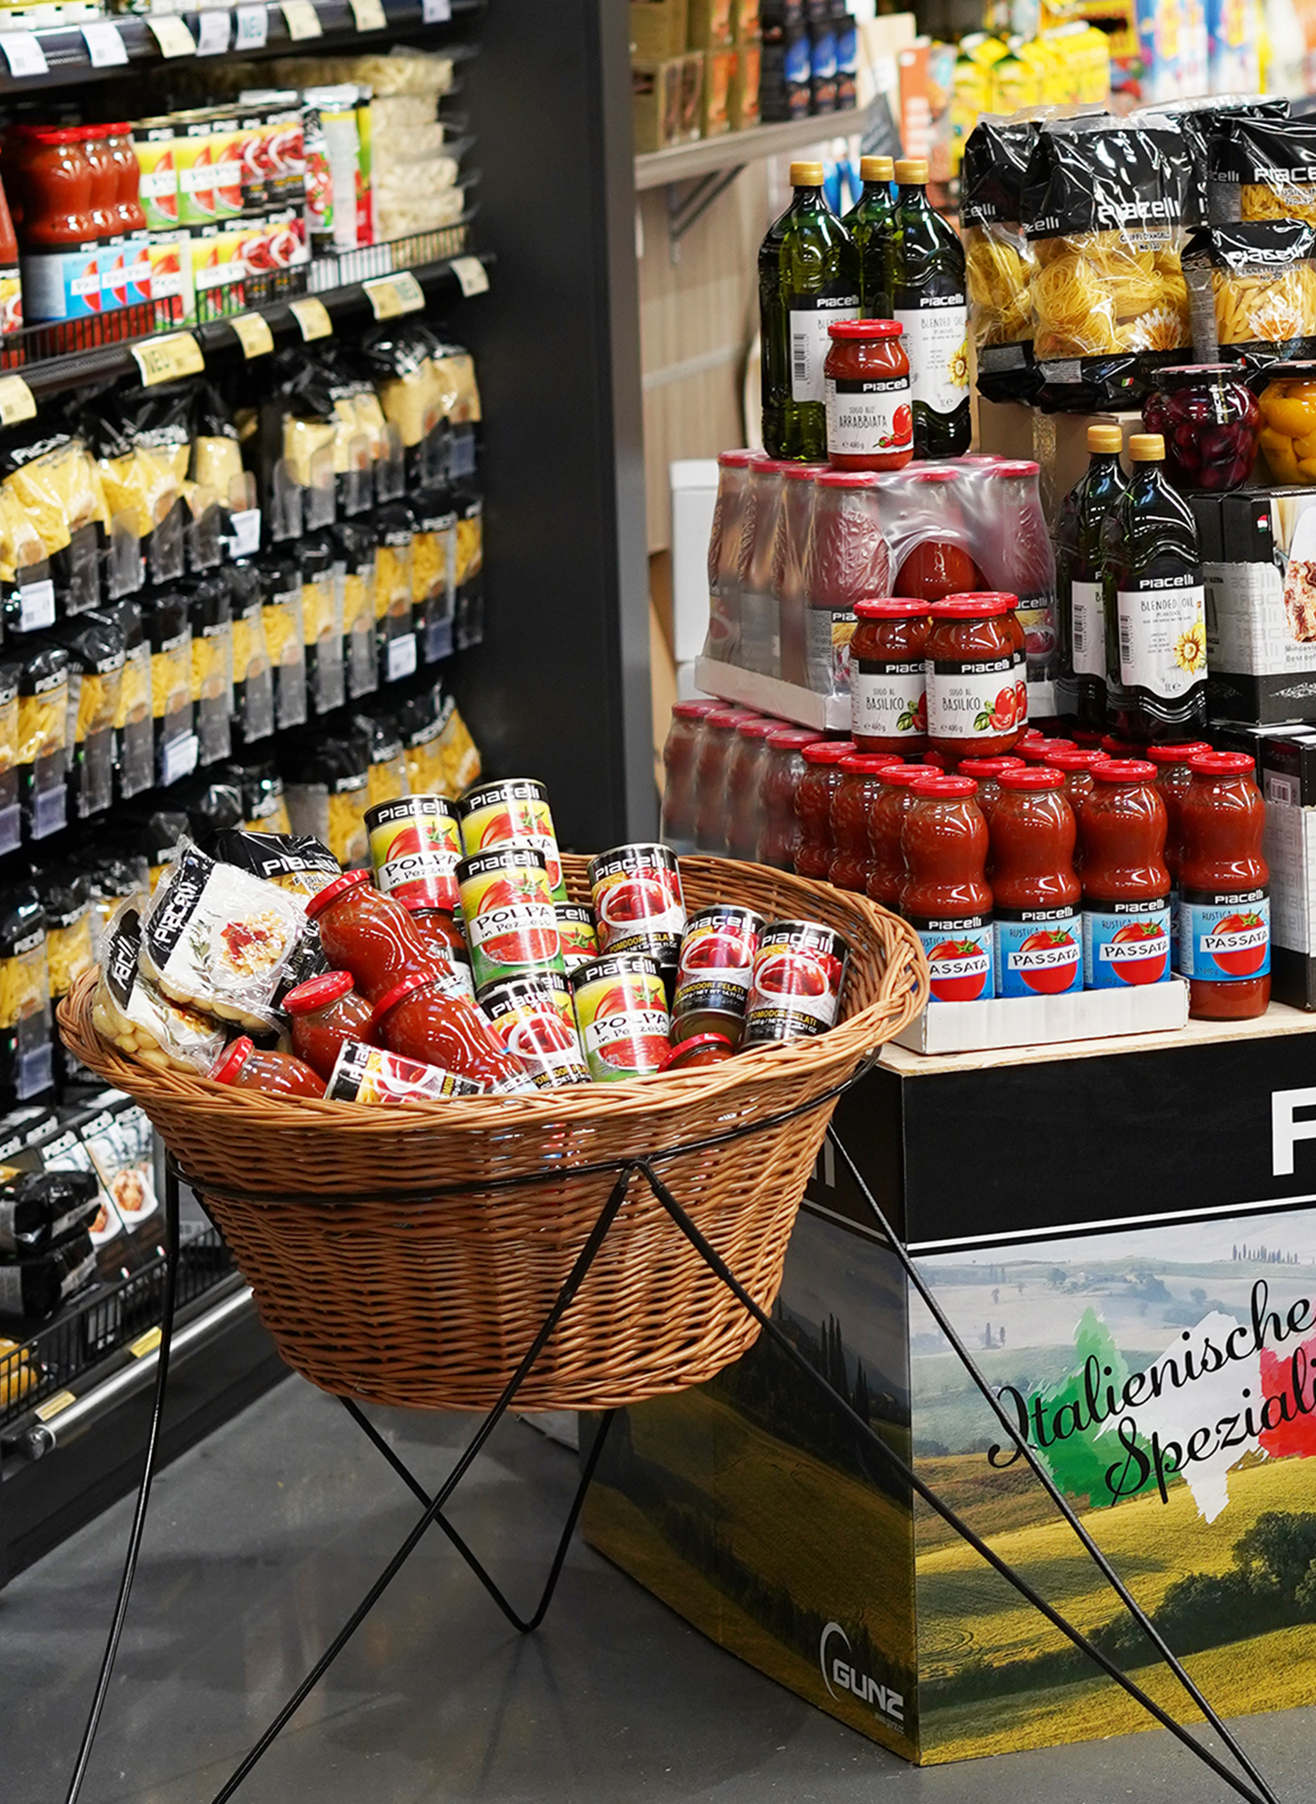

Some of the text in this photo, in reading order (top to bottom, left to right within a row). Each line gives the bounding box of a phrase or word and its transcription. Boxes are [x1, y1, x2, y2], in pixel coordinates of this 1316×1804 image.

[920, 316, 951, 330] BLENDED
[838, 414, 888, 429] ARRABBIATA
[1140, 597, 1195, 612] BLENDED OIL
[866, 697, 905, 711] BASILICO
[942, 697, 981, 711] BASILICO
[384, 853, 460, 878] POLPA
[475, 904, 553, 930] POLPA
[1201, 910, 1233, 921] RUSTICA
[1101, 918, 1132, 929] RUSTICA
[1009, 927, 1041, 938] RUSTICA
[1204, 930, 1269, 950] PASSATA
[920, 937, 947, 947] USTICA
[1104, 938, 1168, 959] PASSATA
[1012, 946, 1079, 968] PASSATA
[930, 959, 988, 976] ASSATA
[832, 1657, 905, 1722] GUNZ
